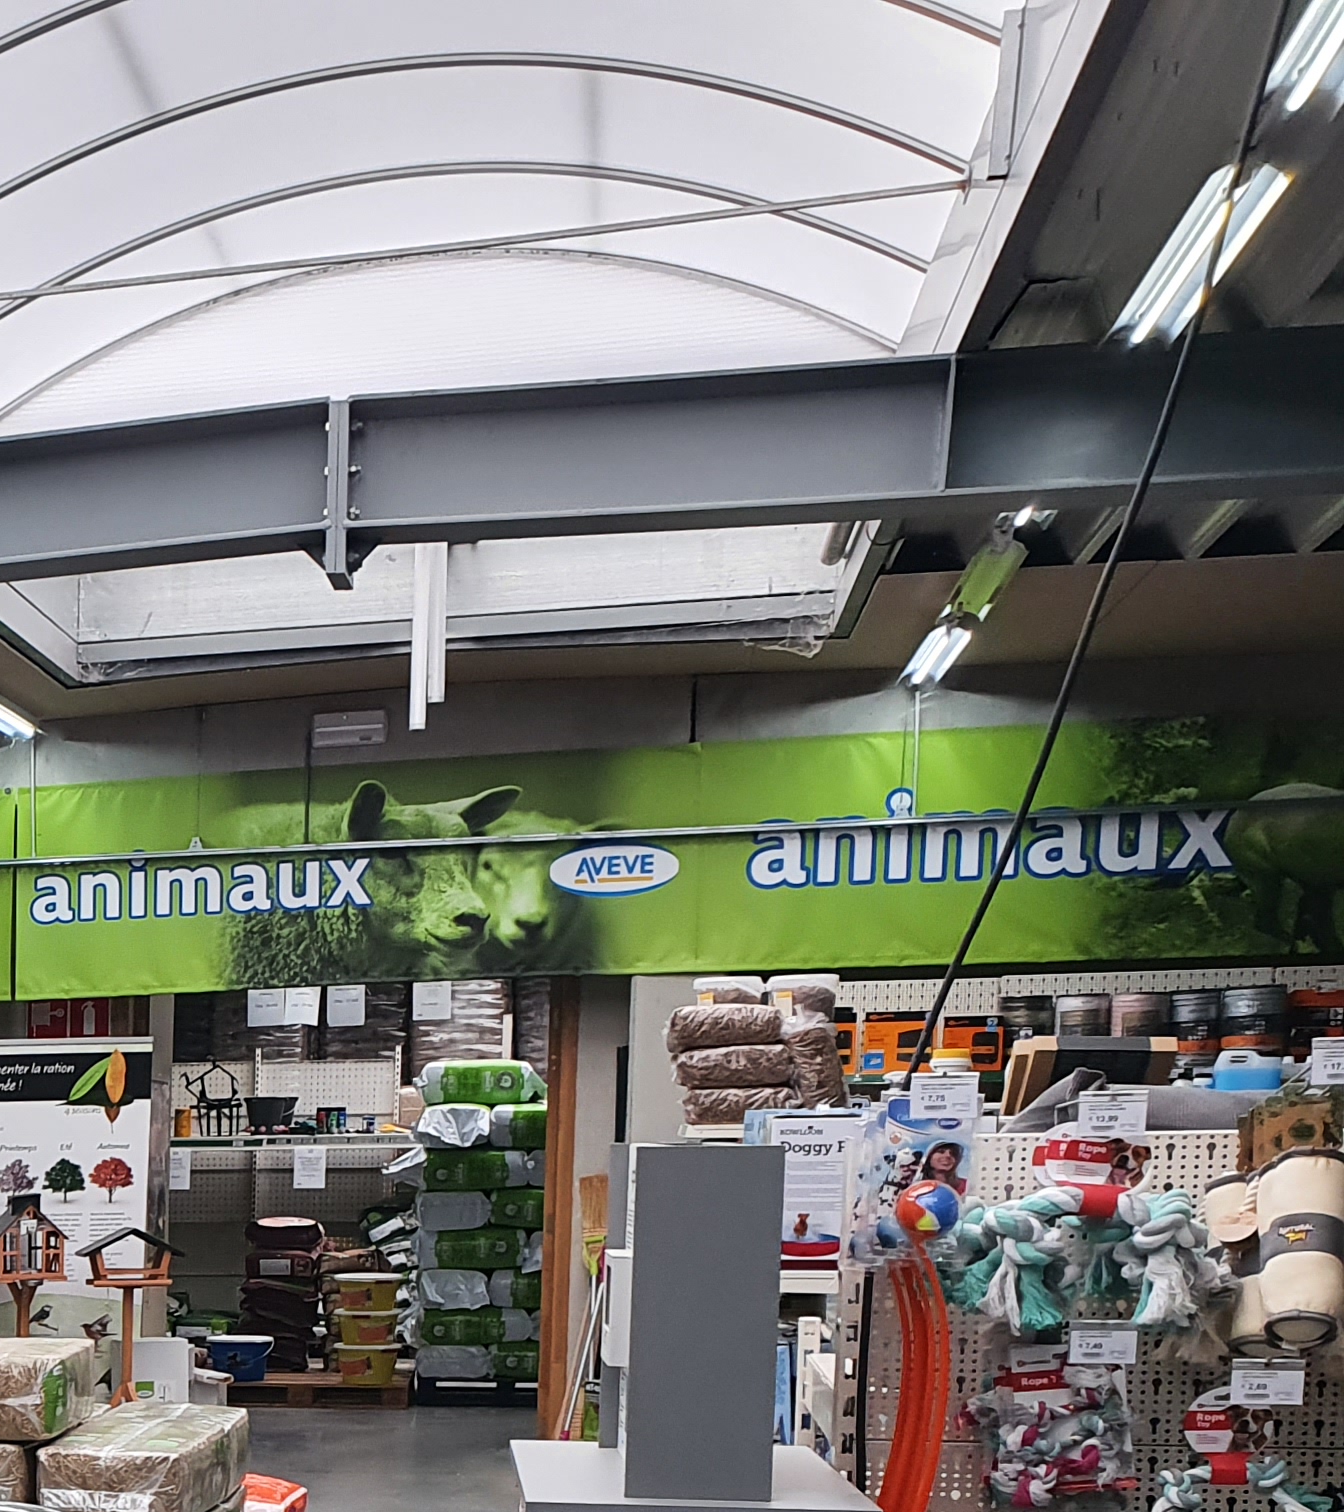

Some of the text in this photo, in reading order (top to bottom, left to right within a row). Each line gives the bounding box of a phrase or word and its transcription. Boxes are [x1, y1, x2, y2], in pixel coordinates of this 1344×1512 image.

[746, 787, 1238, 890] animaux
[574, 852, 656, 885] AVEVE
[29, 850, 373, 924] animaux
[31, 1064, 41, 1074] la
[44, 1063, 75, 1075] ration
[1078, 1143, 1108, 1156] Rope
[1021, 1376, 1049, 1386] Rope
[1196, 1412, 1225, 1424] Rope
